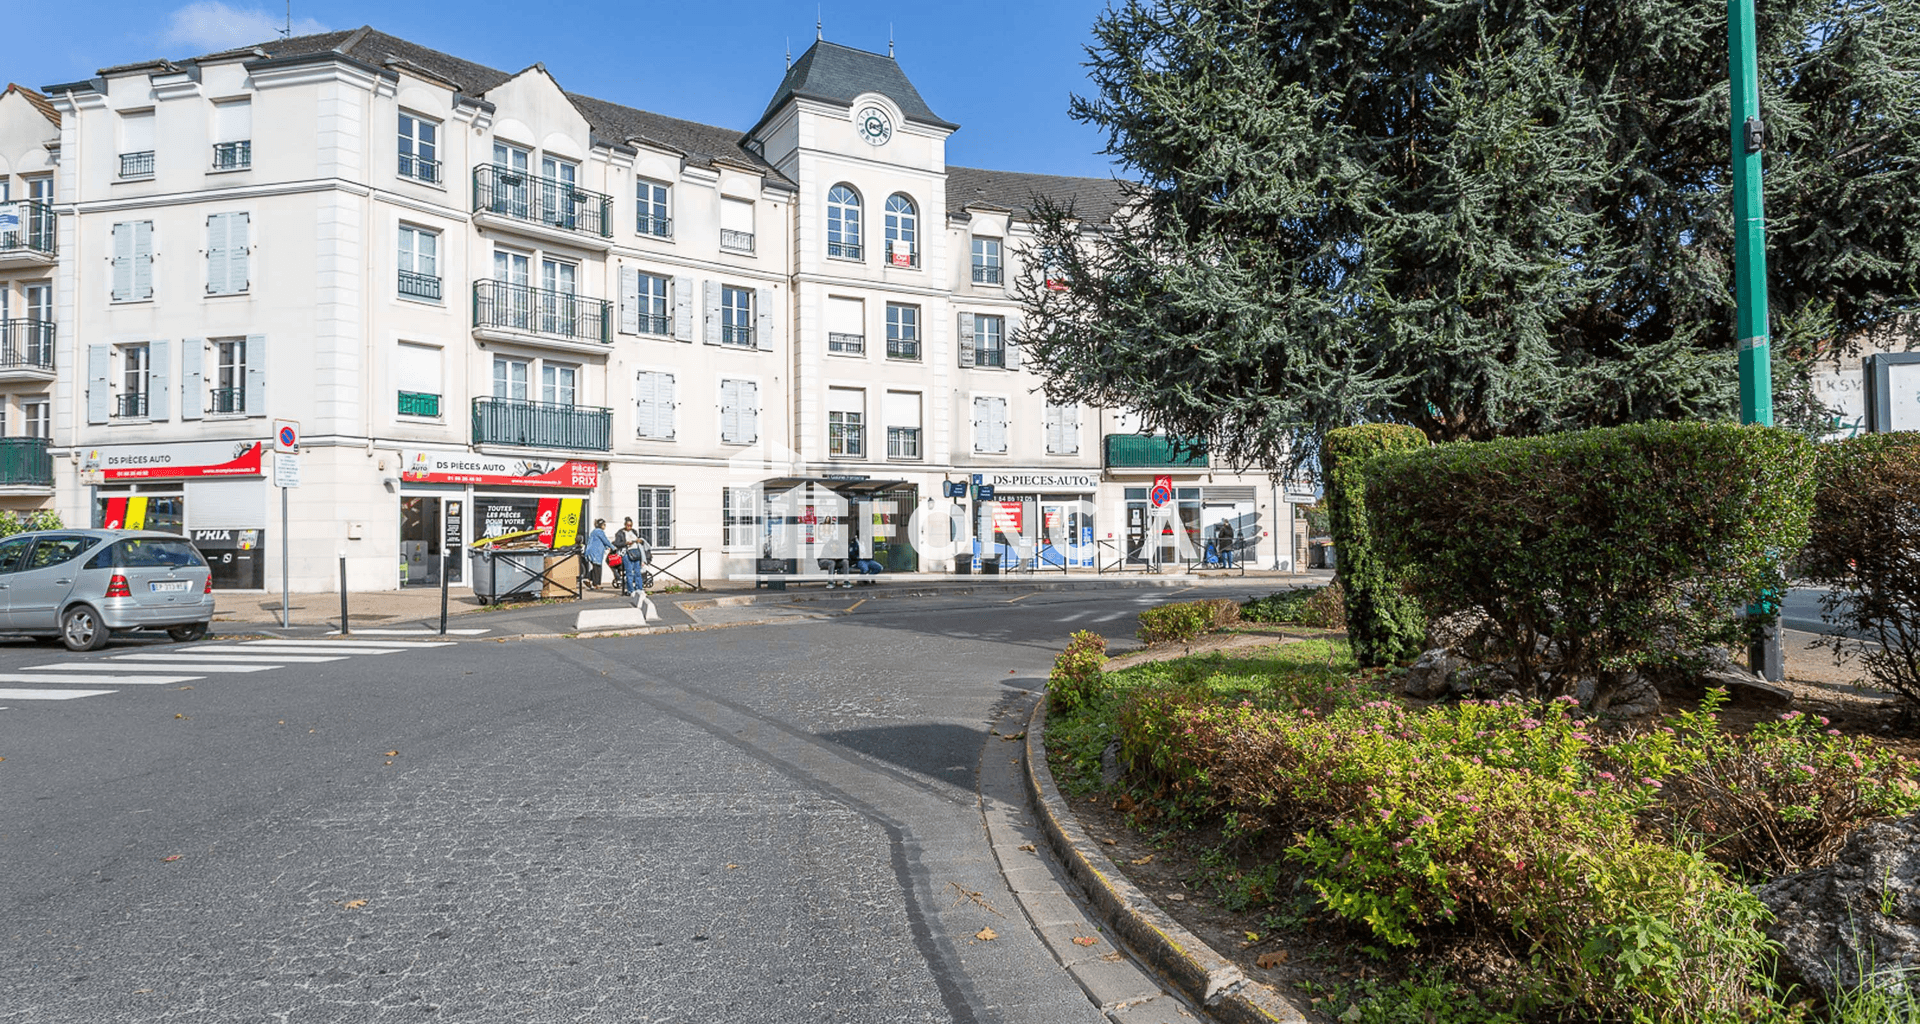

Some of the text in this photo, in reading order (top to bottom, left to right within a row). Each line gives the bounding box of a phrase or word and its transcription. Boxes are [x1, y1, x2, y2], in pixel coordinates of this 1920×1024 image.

[108, 454, 172, 465] DS PIÈCES AUTO
[436, 461, 449, 469] DS
[450, 460, 481, 470] PIÈCES
[482, 464, 506, 472] AUTO
[571, 464, 596, 472] PIÈCES
[571, 476, 595, 486] PRIX
[195, 530, 231, 540] PRIX
